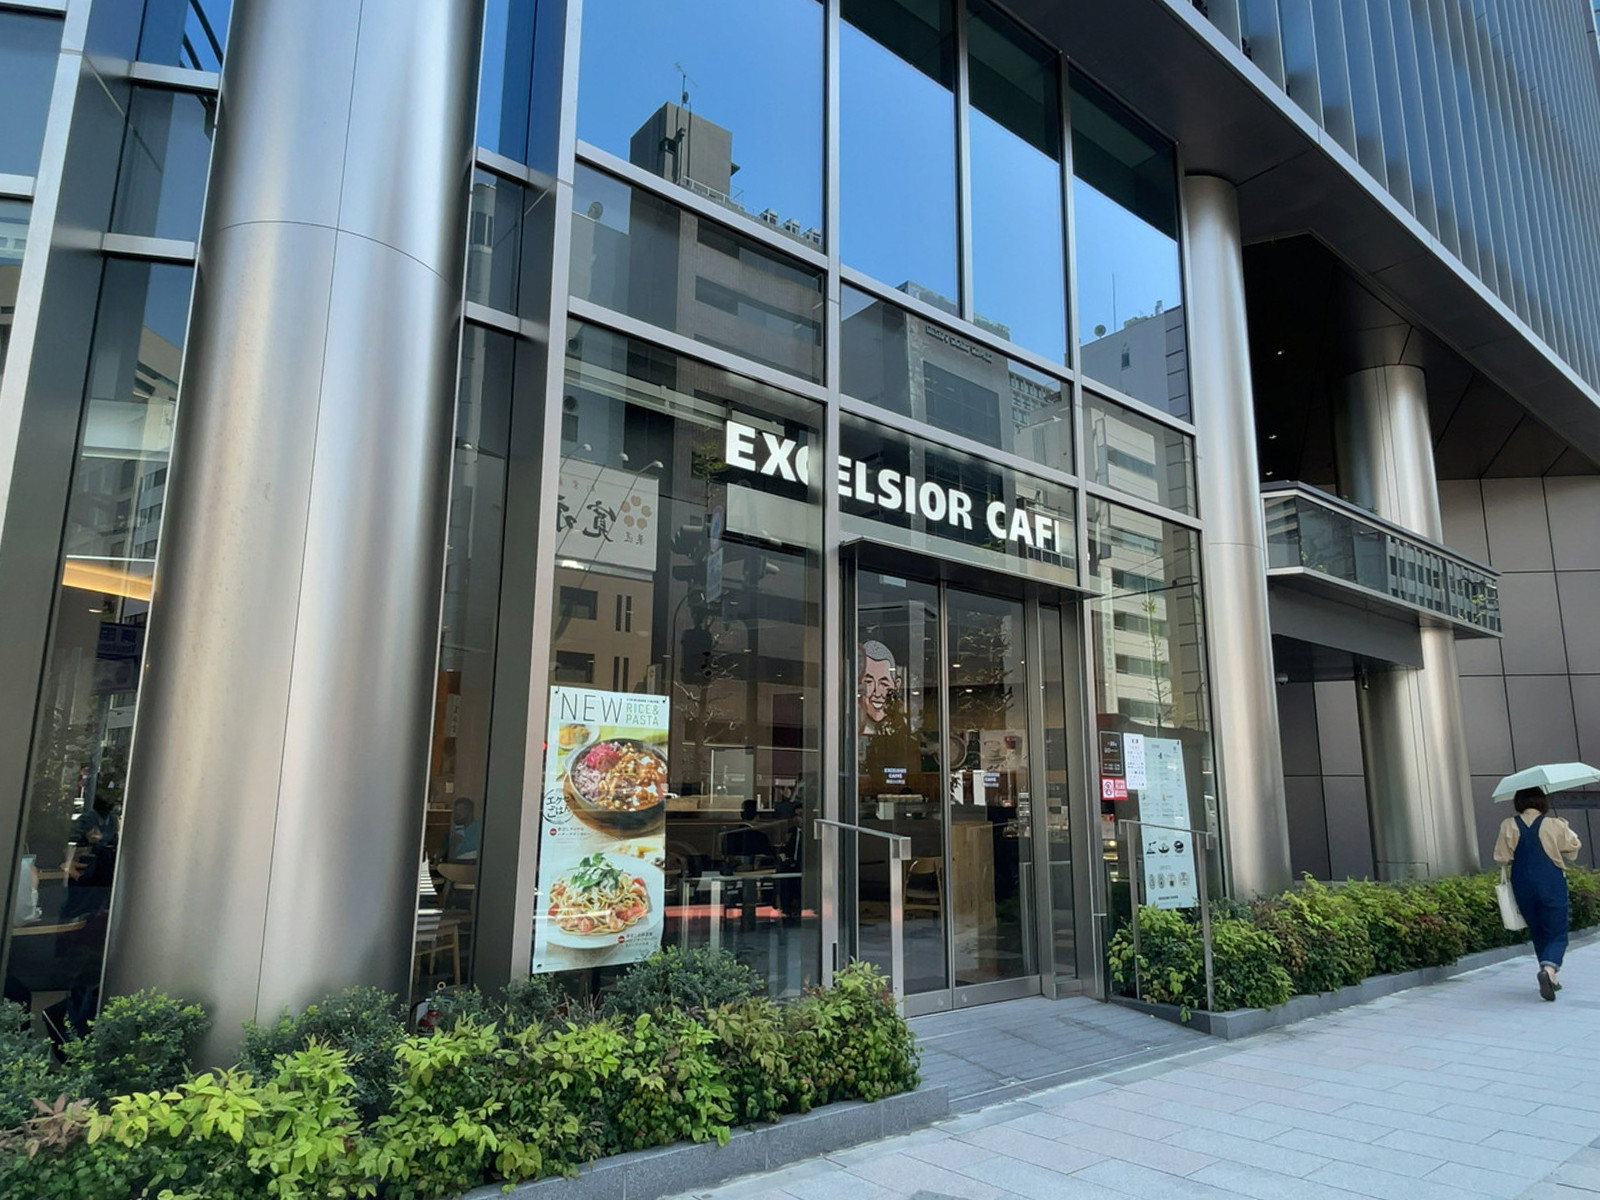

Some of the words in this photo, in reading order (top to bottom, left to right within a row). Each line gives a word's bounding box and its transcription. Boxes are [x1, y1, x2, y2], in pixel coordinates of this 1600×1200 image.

[561, 693, 623, 723] NEW
[626, 703, 659, 715] RICE&
[625, 714, 659, 726] PASTA
[547, 803, 571, 818] ごはん
